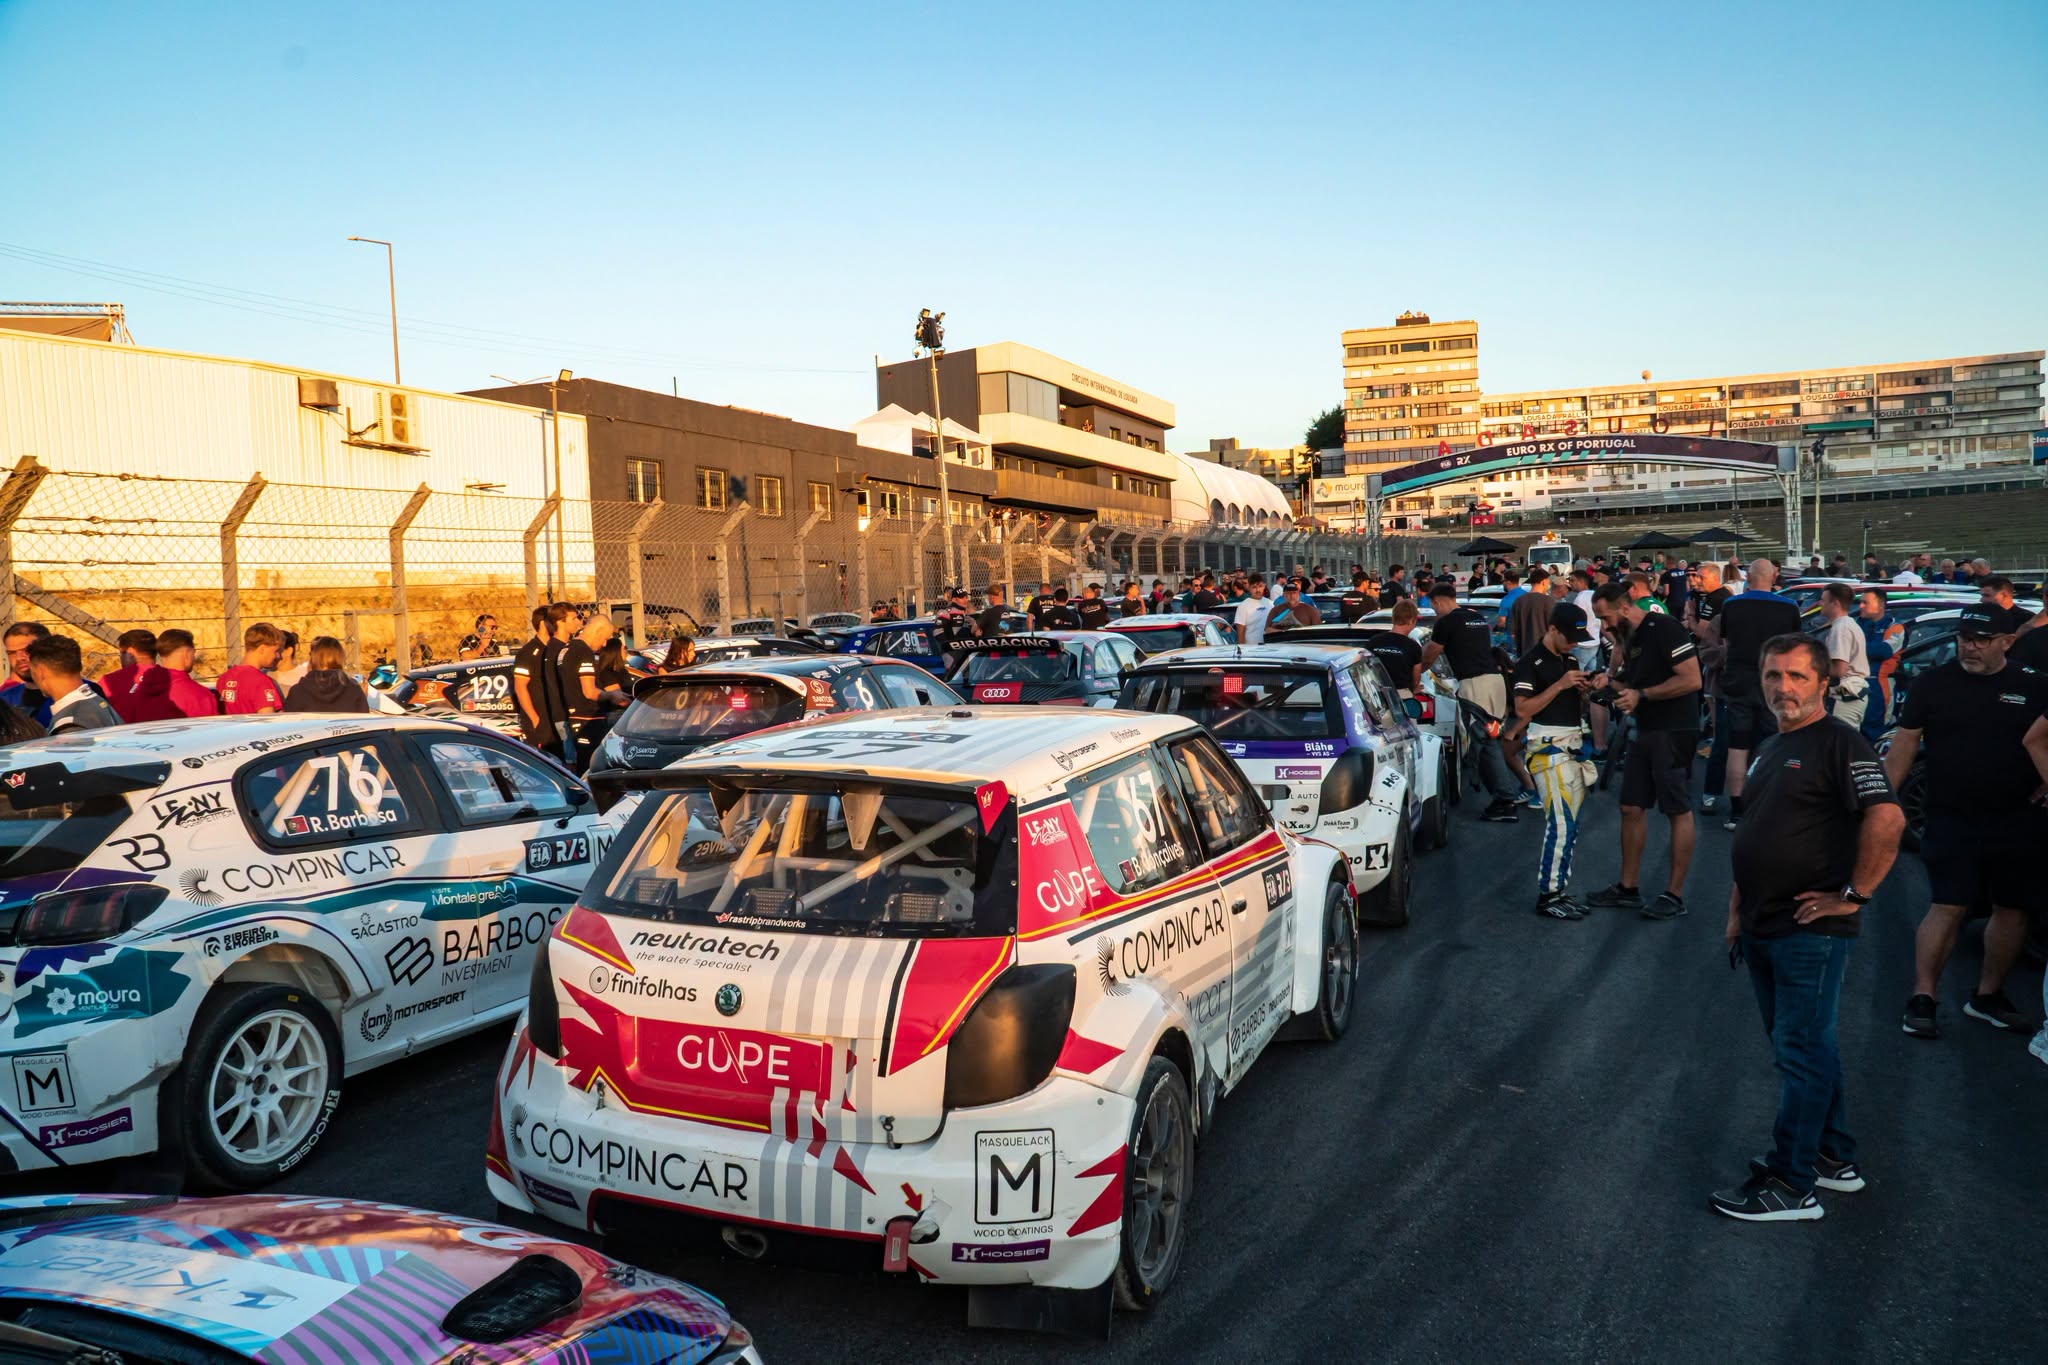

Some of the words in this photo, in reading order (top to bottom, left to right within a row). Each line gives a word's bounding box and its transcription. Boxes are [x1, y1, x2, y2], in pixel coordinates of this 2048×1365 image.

[1072, 373, 1089, 387] CIRCUITO
[1801, 391, 1839, 401] LOUSADA
[1845, 390, 1872, 399] RALLY
[1523, 413, 1557, 422] LOUSADA
[1562, 411, 1586, 419] RALLY
[1658, 404, 1694, 412] LOUSADA
[1927, 406, 1954, 415] RALLY
[1775, 418, 1800, 426] RALLY
[1506, 444, 1536, 456] EURO
[1539, 442, 1555, 452] RX
[1558, 441, 1573, 450] OF
[1576, 438, 1636, 450] PORTUGAL
[1456, 456, 1471, 466] RX
[949, 637, 1050, 650] BIBARACING
[470, 675, 508, 699] 129
[202, 744, 248, 762] moura
[767, 741, 923, 760] 67
[308, 753, 382, 812] 76
[1130, 770, 1166, 844] 67
[556, 838, 588, 863] RX3
[222, 846, 406, 893] COMPINCAR
[351, 915, 418, 939] SACASTRO
[728, 914, 806, 929] rastripbrandworks
[224, 926, 267, 943] RIBEIRO
[225, 930, 280, 951] &MOREIRA
[1122, 899, 1225, 979] COMPINCAR
[630, 931, 781, 961] neutratech
[441, 955, 513, 986] INVESTMENT
[636, 951, 655, 961] the
[658, 953, 692, 966] water
[695, 957, 753, 973] specialist
[78, 987, 141, 1005] moura
[611, 972, 698, 1002] finifolhas
[394, 990, 467, 1021] MOTORSPORT
[1242, 1002, 1266, 1043] BARBOS
[15, 1056, 64, 1066] MASQUELACK
[24, 1067, 65, 1106] M
[20, 1111, 42, 1120] WOOD
[44, 1108, 78, 1118] COATINGS
[67, 1114, 129, 1139] HOOSIER
[278, 1107, 333, 1172] HOOSIER
[979, 1136, 1051, 1147] MASQUELACK
[530, 1122, 748, 1201] COMPINCAR
[990, 1153, 1041, 1217] M
[974, 1228, 1005, 1238] WOOD
[1007, 1225, 1054, 1238] COATINGS
[980, 1247, 1046, 1258] HOOSIER
